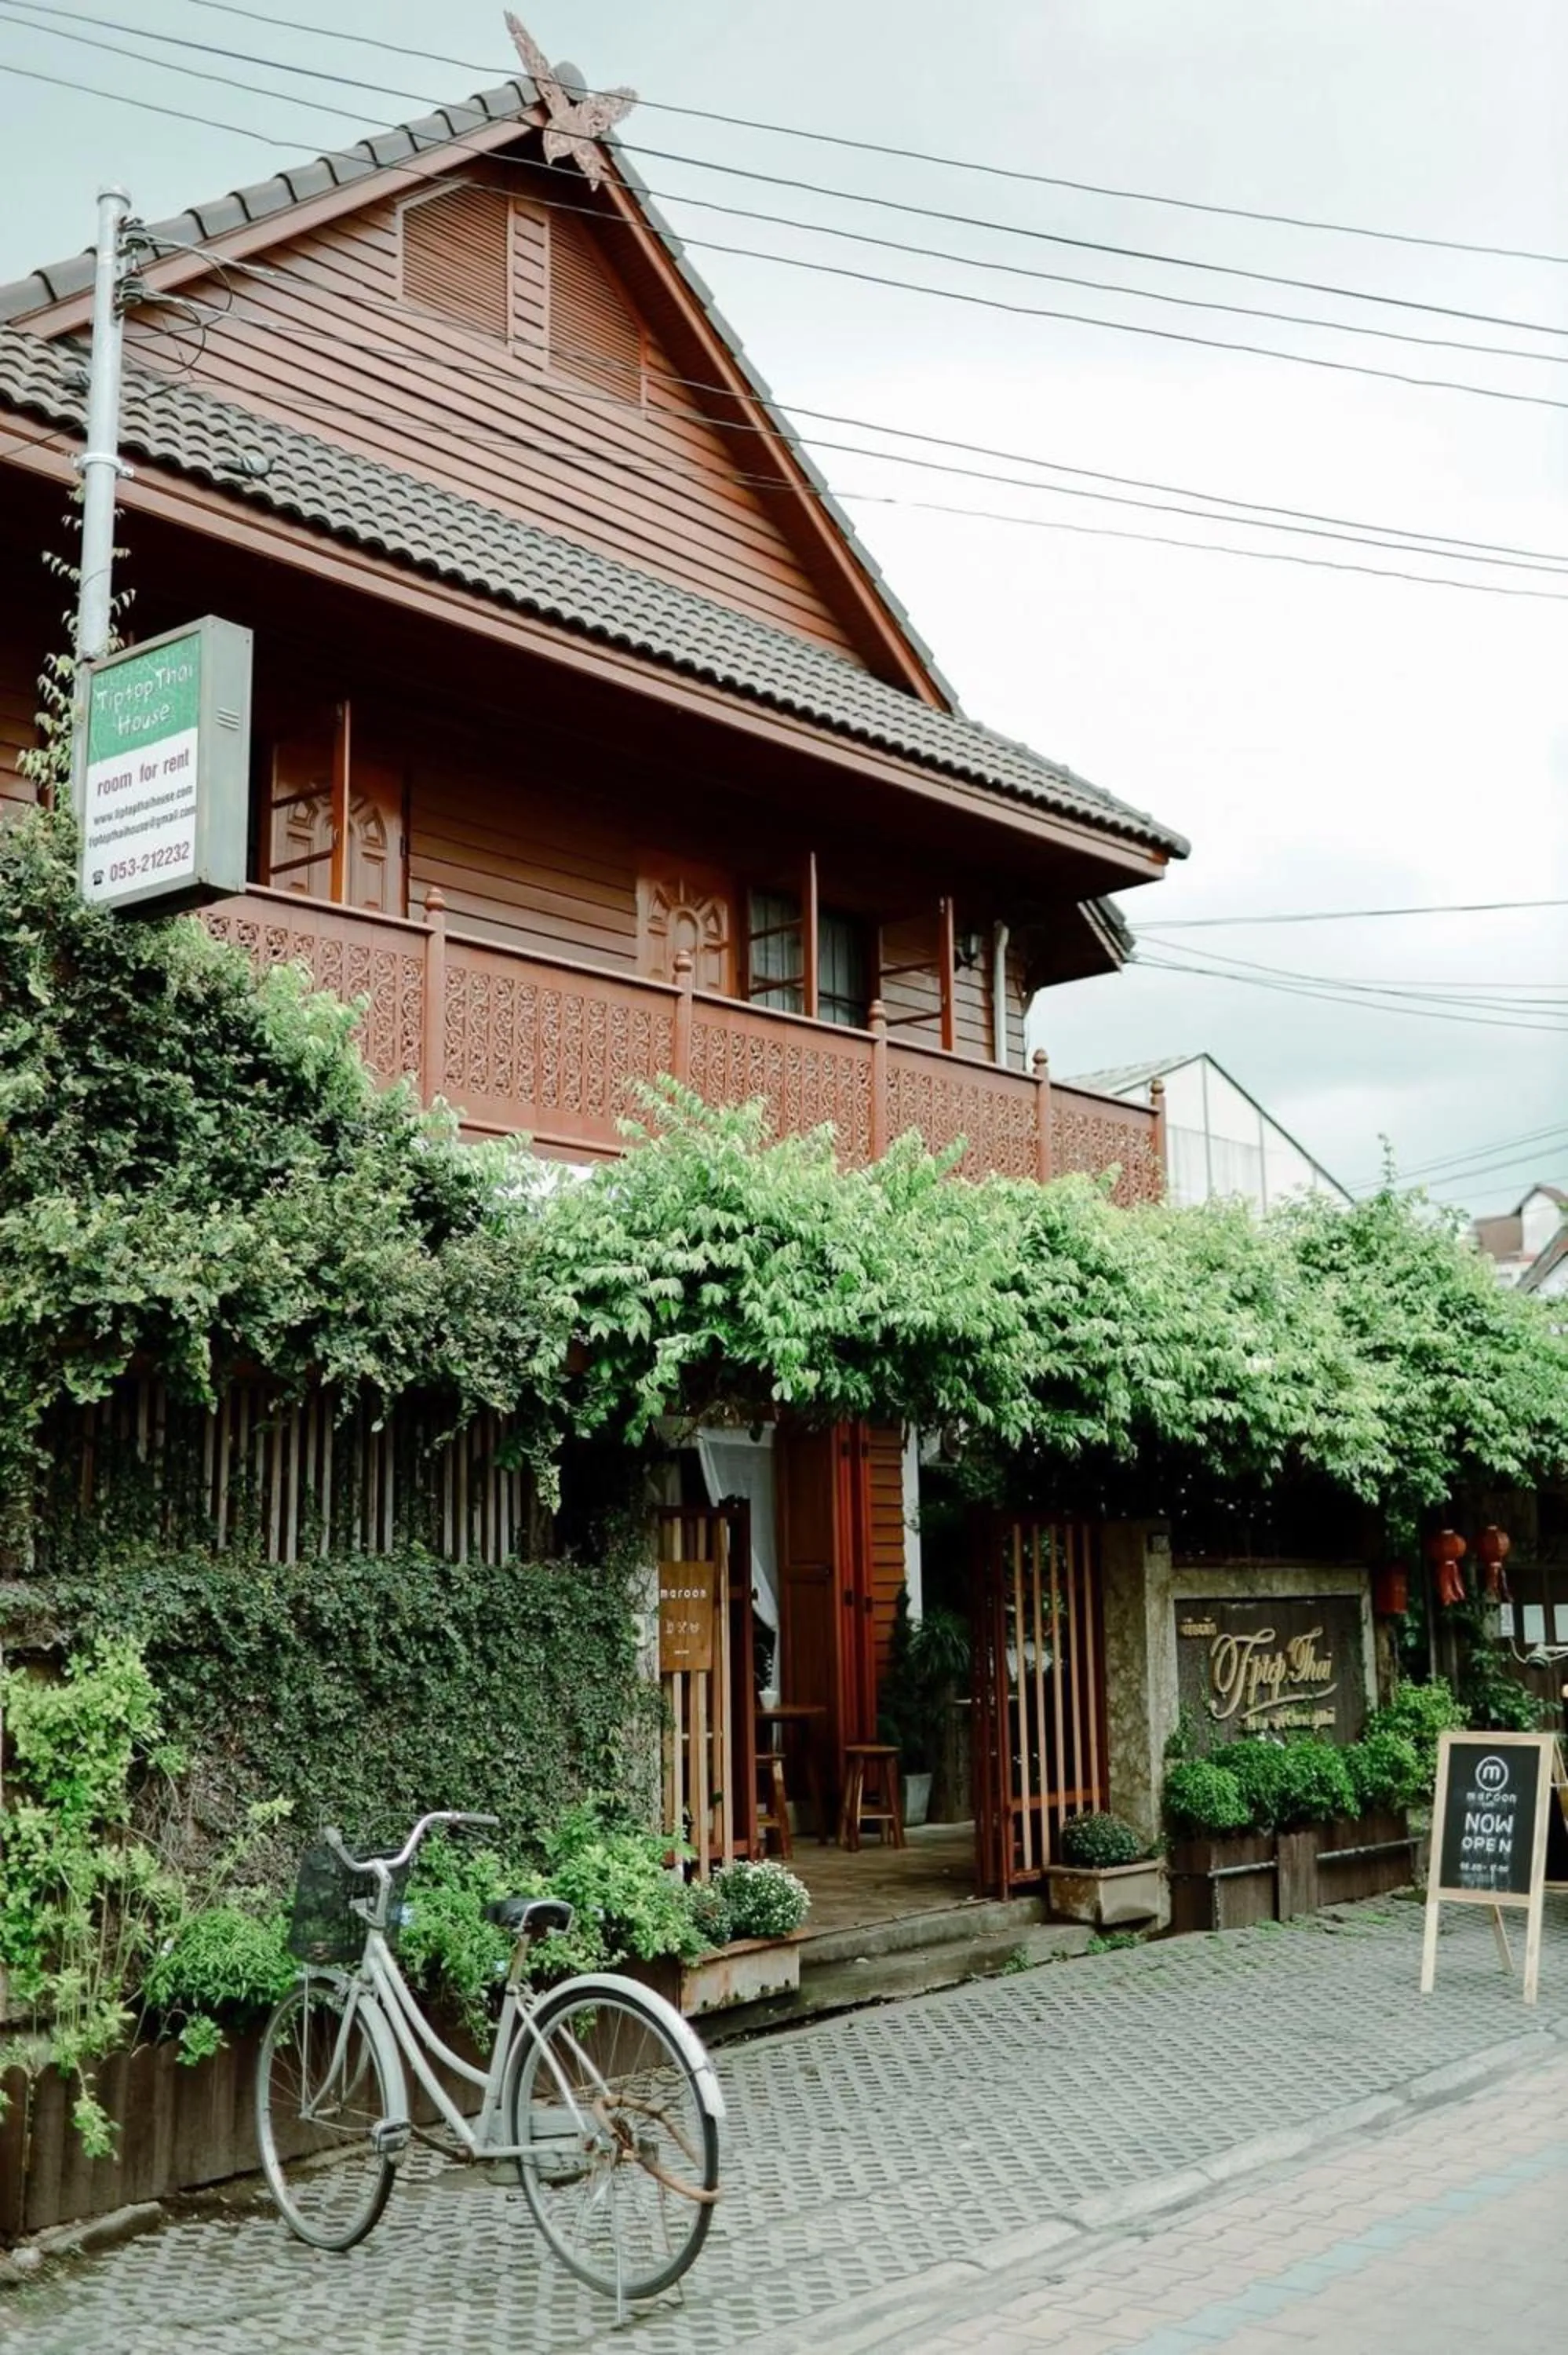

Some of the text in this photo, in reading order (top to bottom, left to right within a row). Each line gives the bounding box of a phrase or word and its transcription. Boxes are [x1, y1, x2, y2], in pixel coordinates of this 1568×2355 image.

[97, 665, 192, 714] Tiptop Thai
[118, 703, 170, 736] House
[97, 748, 189, 797] room for rent
[110, 841, 190, 882] 053-212232
[1464, 1812, 1514, 1835] NOW
[1461, 1836, 1511, 1853] OPEN
